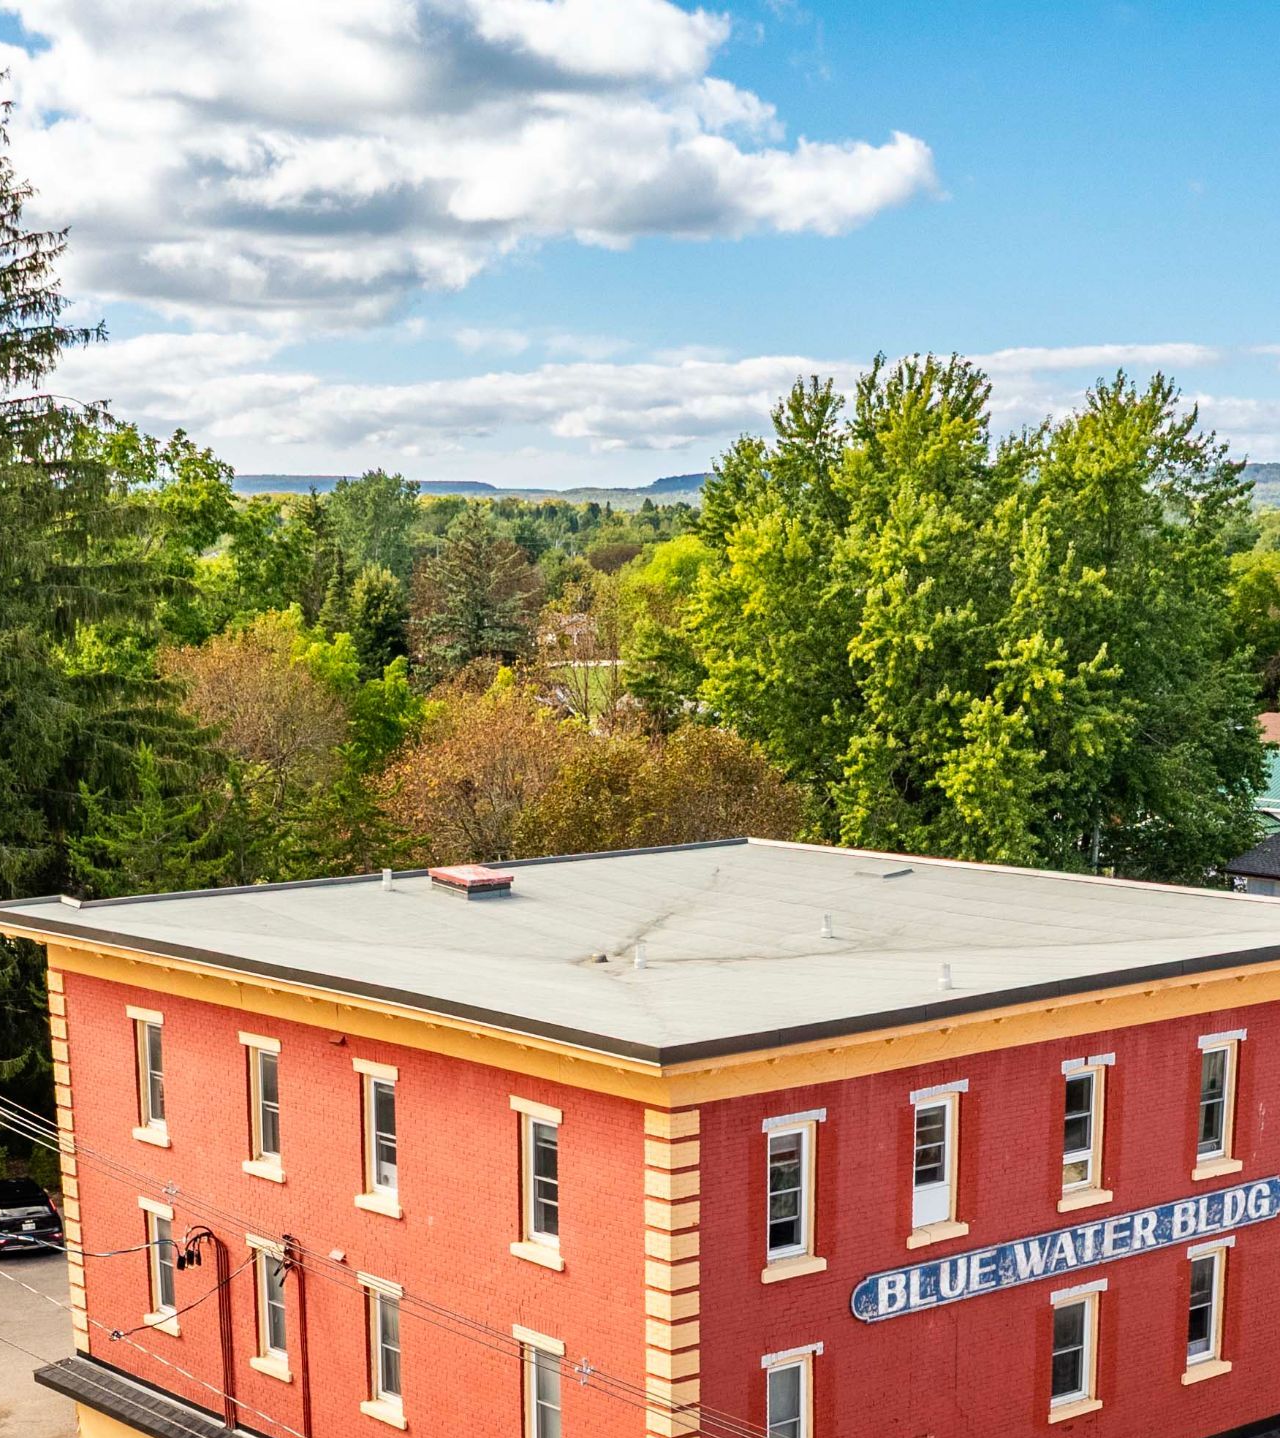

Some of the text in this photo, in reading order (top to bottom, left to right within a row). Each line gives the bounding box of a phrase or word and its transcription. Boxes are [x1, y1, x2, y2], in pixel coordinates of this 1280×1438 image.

[876, 1183, 1272, 1315] BLUE WATER BLDG
